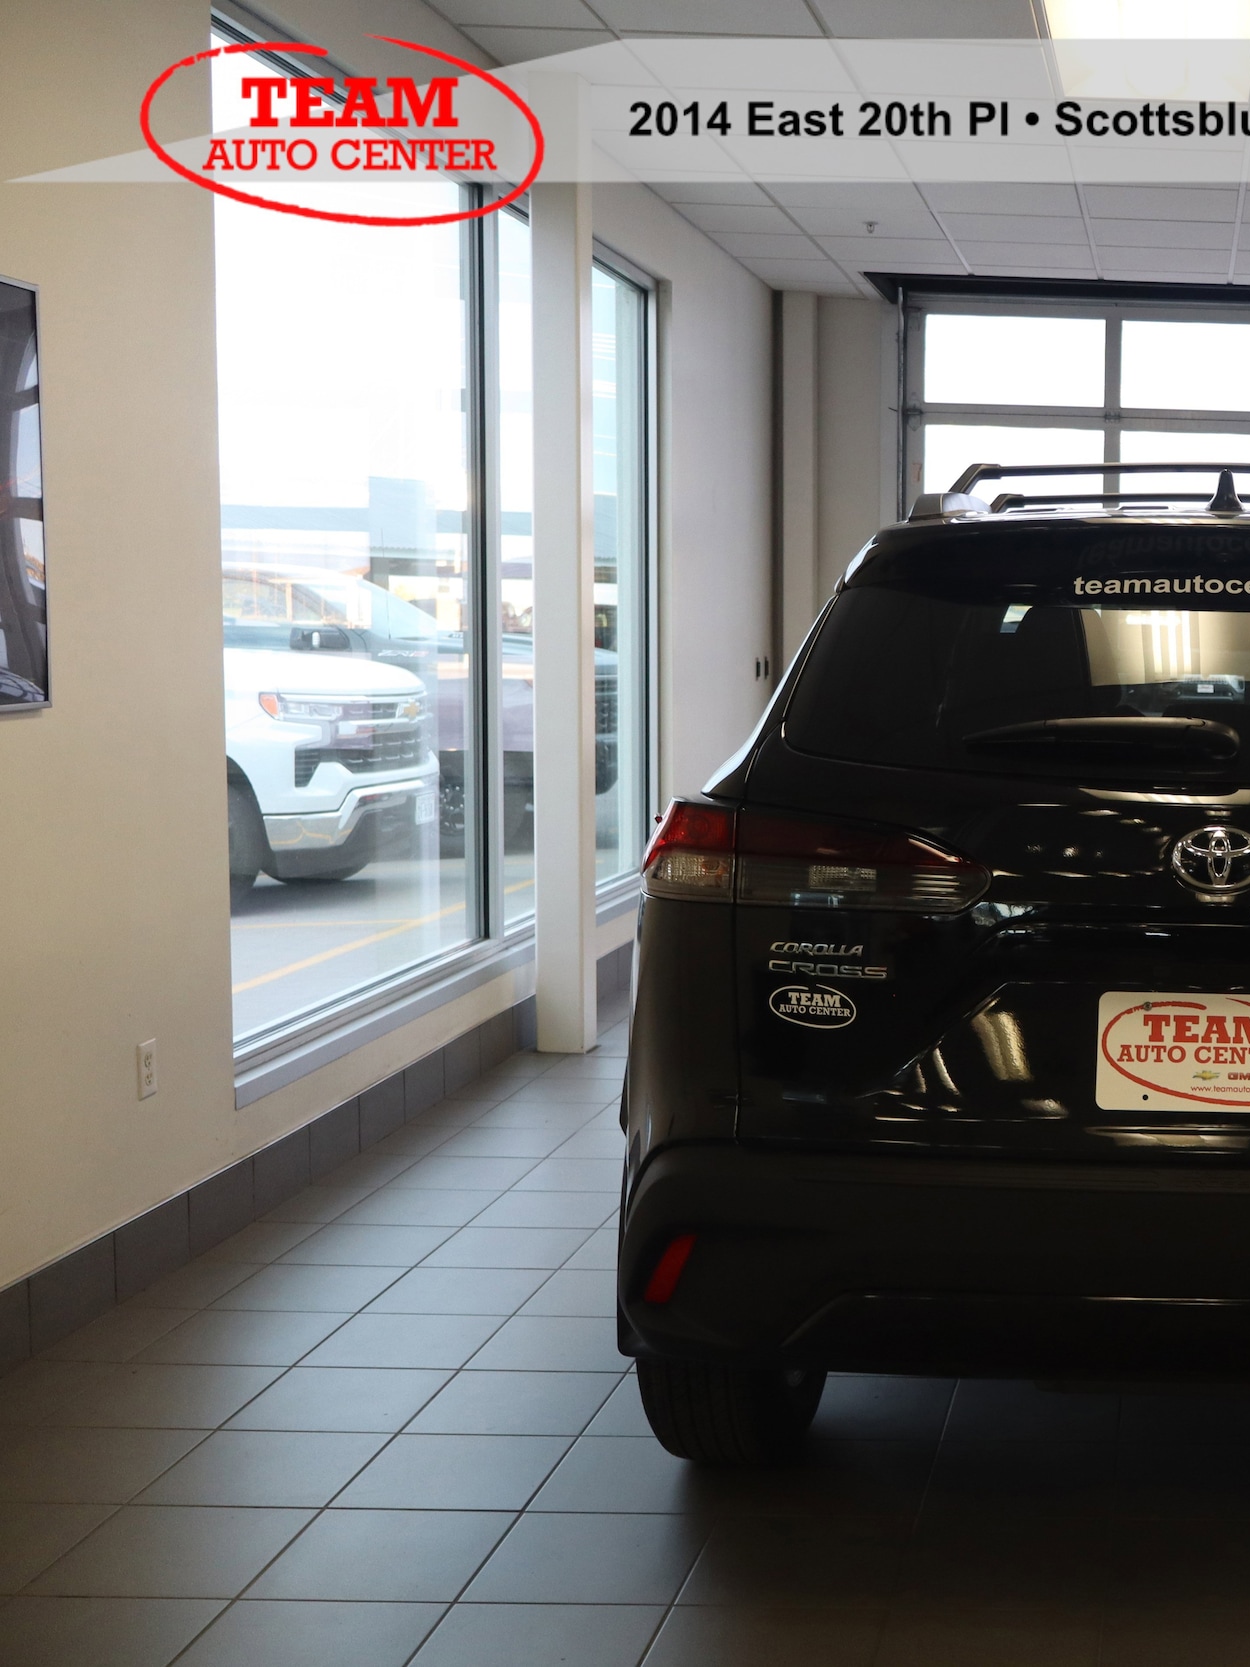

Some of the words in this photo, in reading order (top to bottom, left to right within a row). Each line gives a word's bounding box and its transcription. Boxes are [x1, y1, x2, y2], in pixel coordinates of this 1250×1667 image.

[770, 941, 864, 957] COROLLA
[768, 960, 888, 979] CROSS
[788, 991, 842, 1008] TEAM
[778, 1004, 807, 1014] AUTO
[808, 1006, 851, 1017] CENTER
[1117, 1044, 1187, 1064] AUTO
